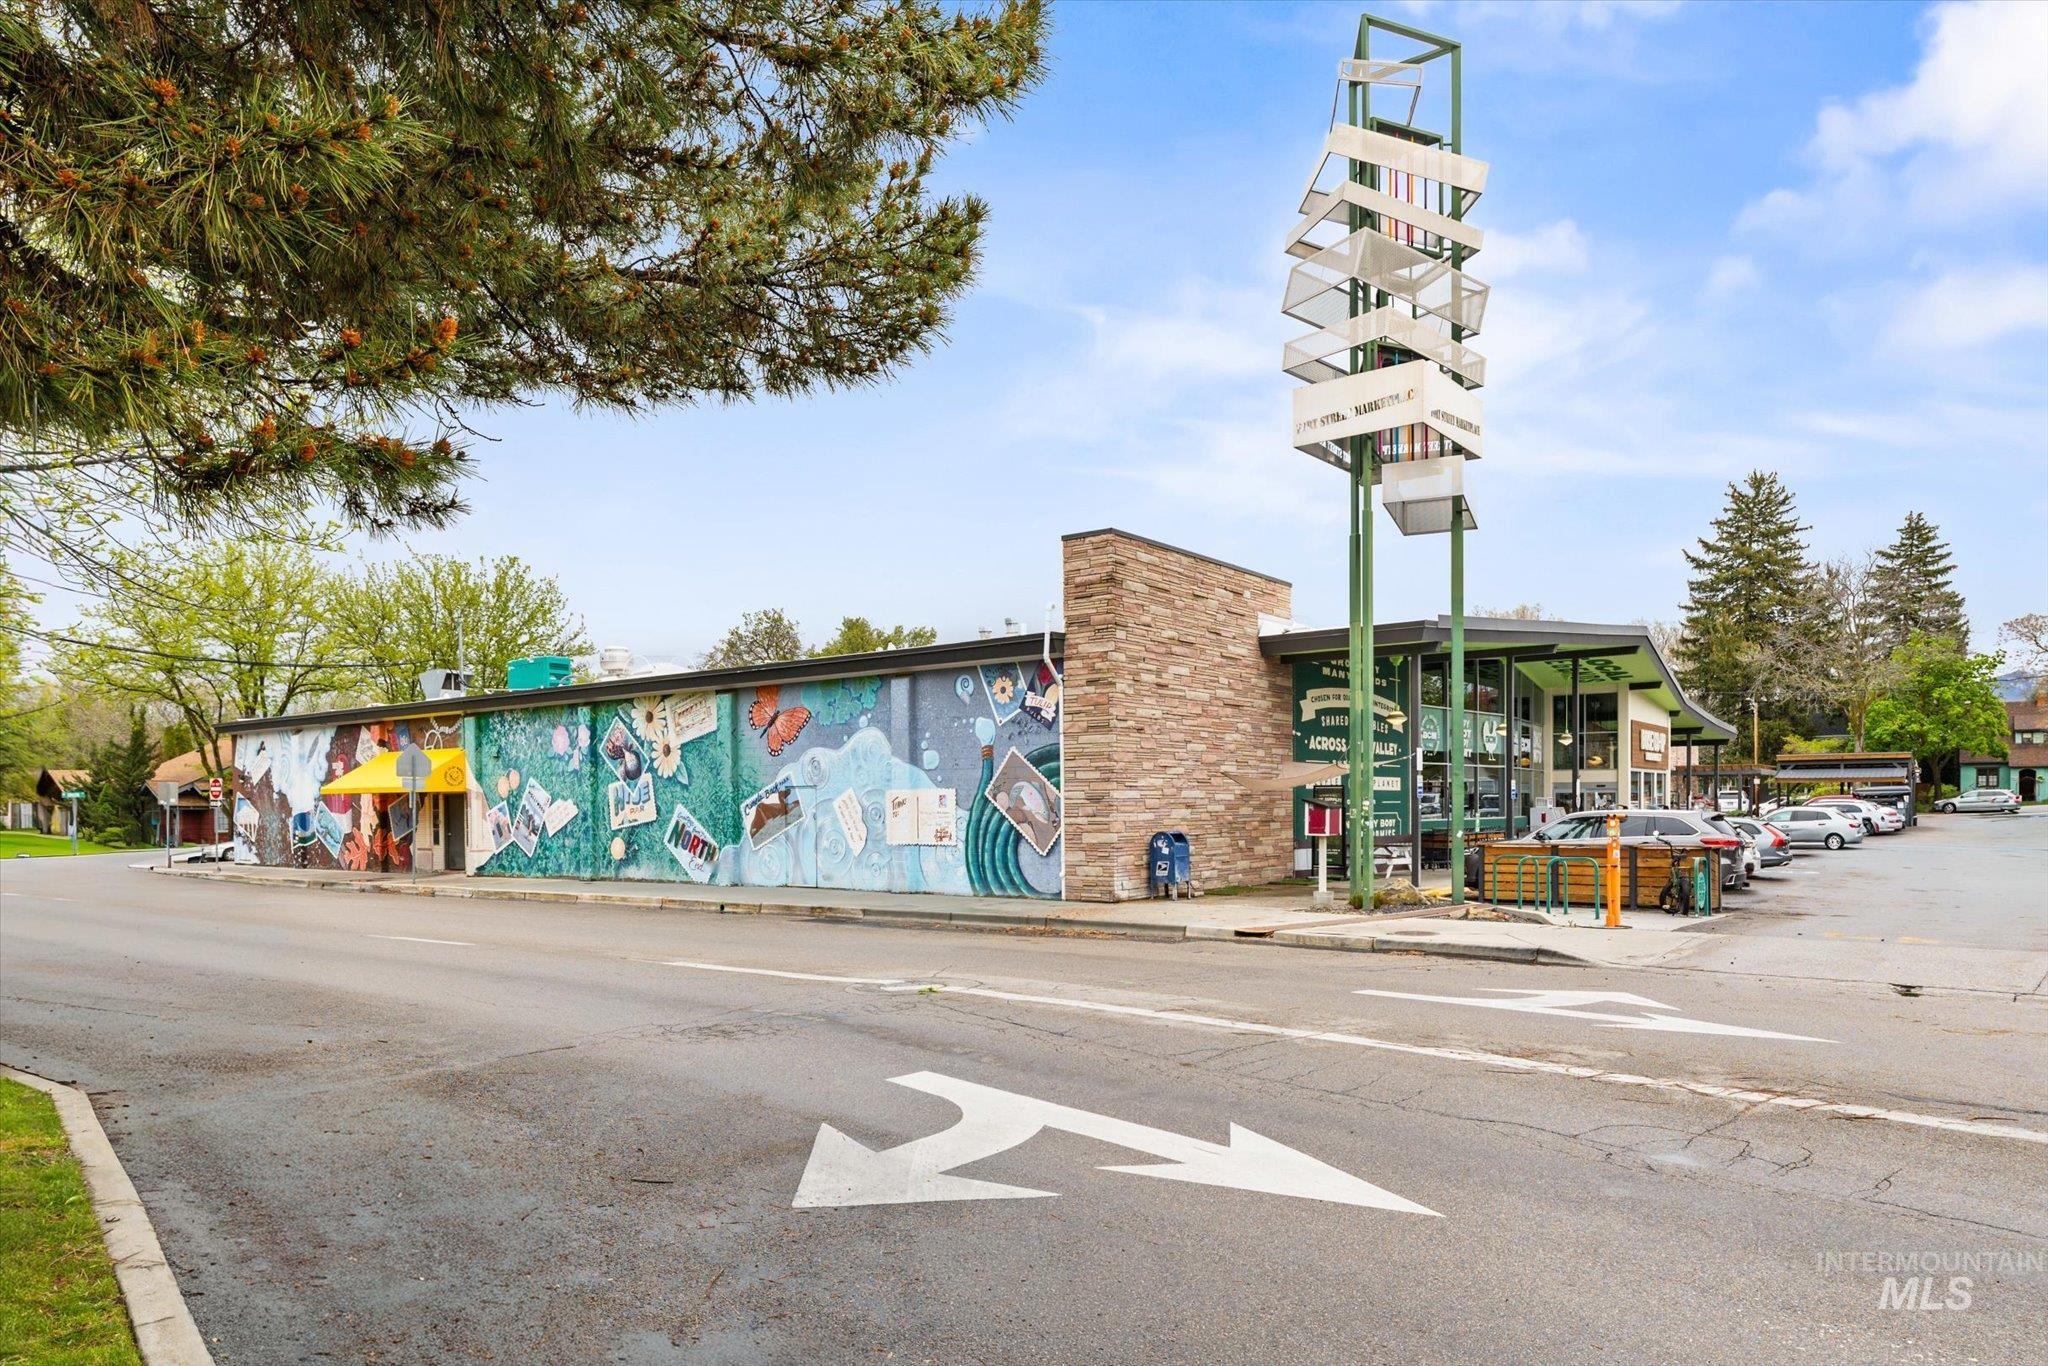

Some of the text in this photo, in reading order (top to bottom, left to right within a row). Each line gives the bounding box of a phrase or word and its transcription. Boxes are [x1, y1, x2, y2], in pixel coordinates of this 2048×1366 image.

[1030, 696, 1052, 710] TULIP
[1311, 693, 1331, 703] CHOSEN
[1332, 693, 1341, 701] FOR
[1320, 715, 1349, 727] SHARED
[1308, 735, 1347, 752] ACROSS
[1380, 819, 1396, 828] BODY
[667, 820, 718, 864] NORTH
